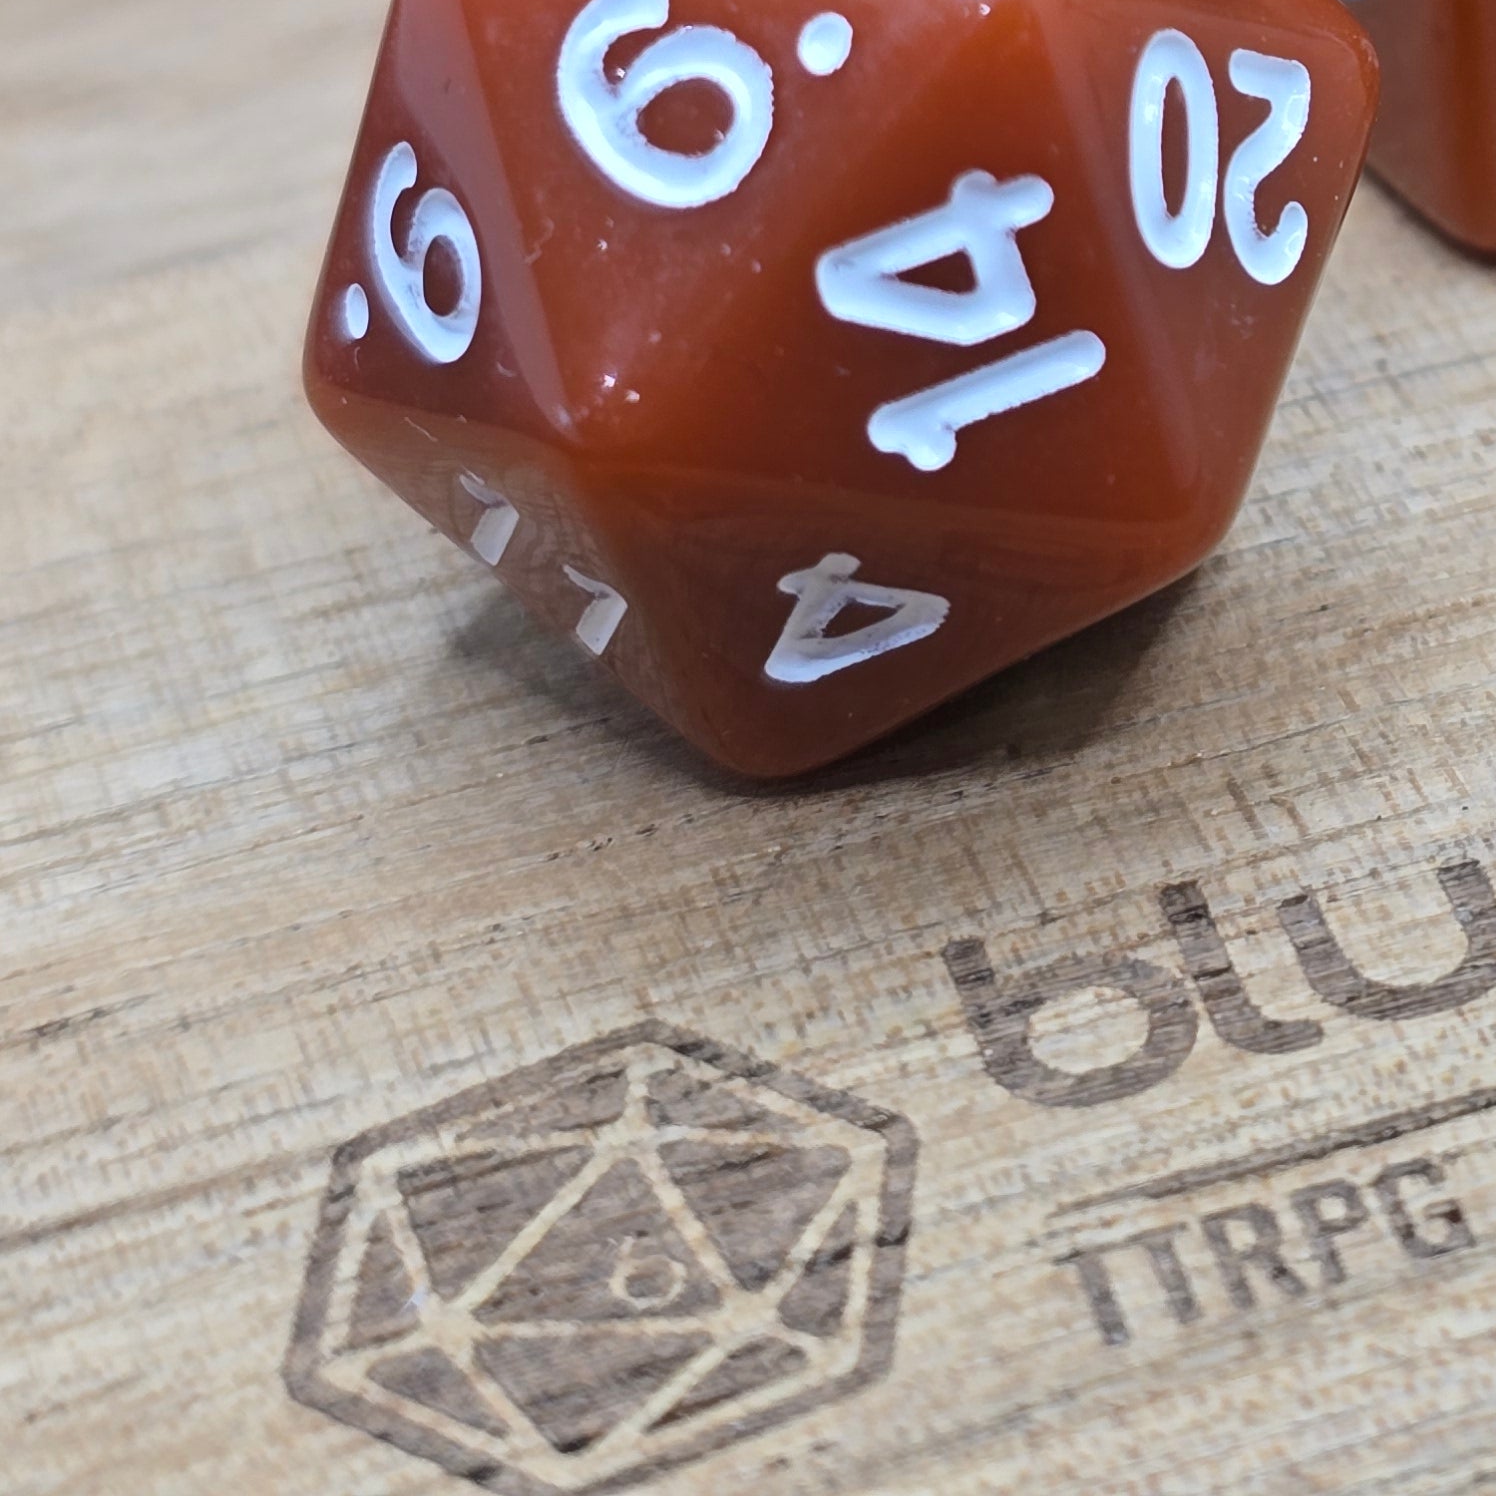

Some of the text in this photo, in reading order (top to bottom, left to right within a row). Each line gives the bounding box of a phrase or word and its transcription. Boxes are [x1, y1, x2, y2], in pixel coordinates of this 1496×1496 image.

[1128, 26, 1312, 286] 20
[815, 168, 1106, 472] 14
[764, 552, 952, 684] 4
[1052, 1156, 1478, 1348] TTRPG
